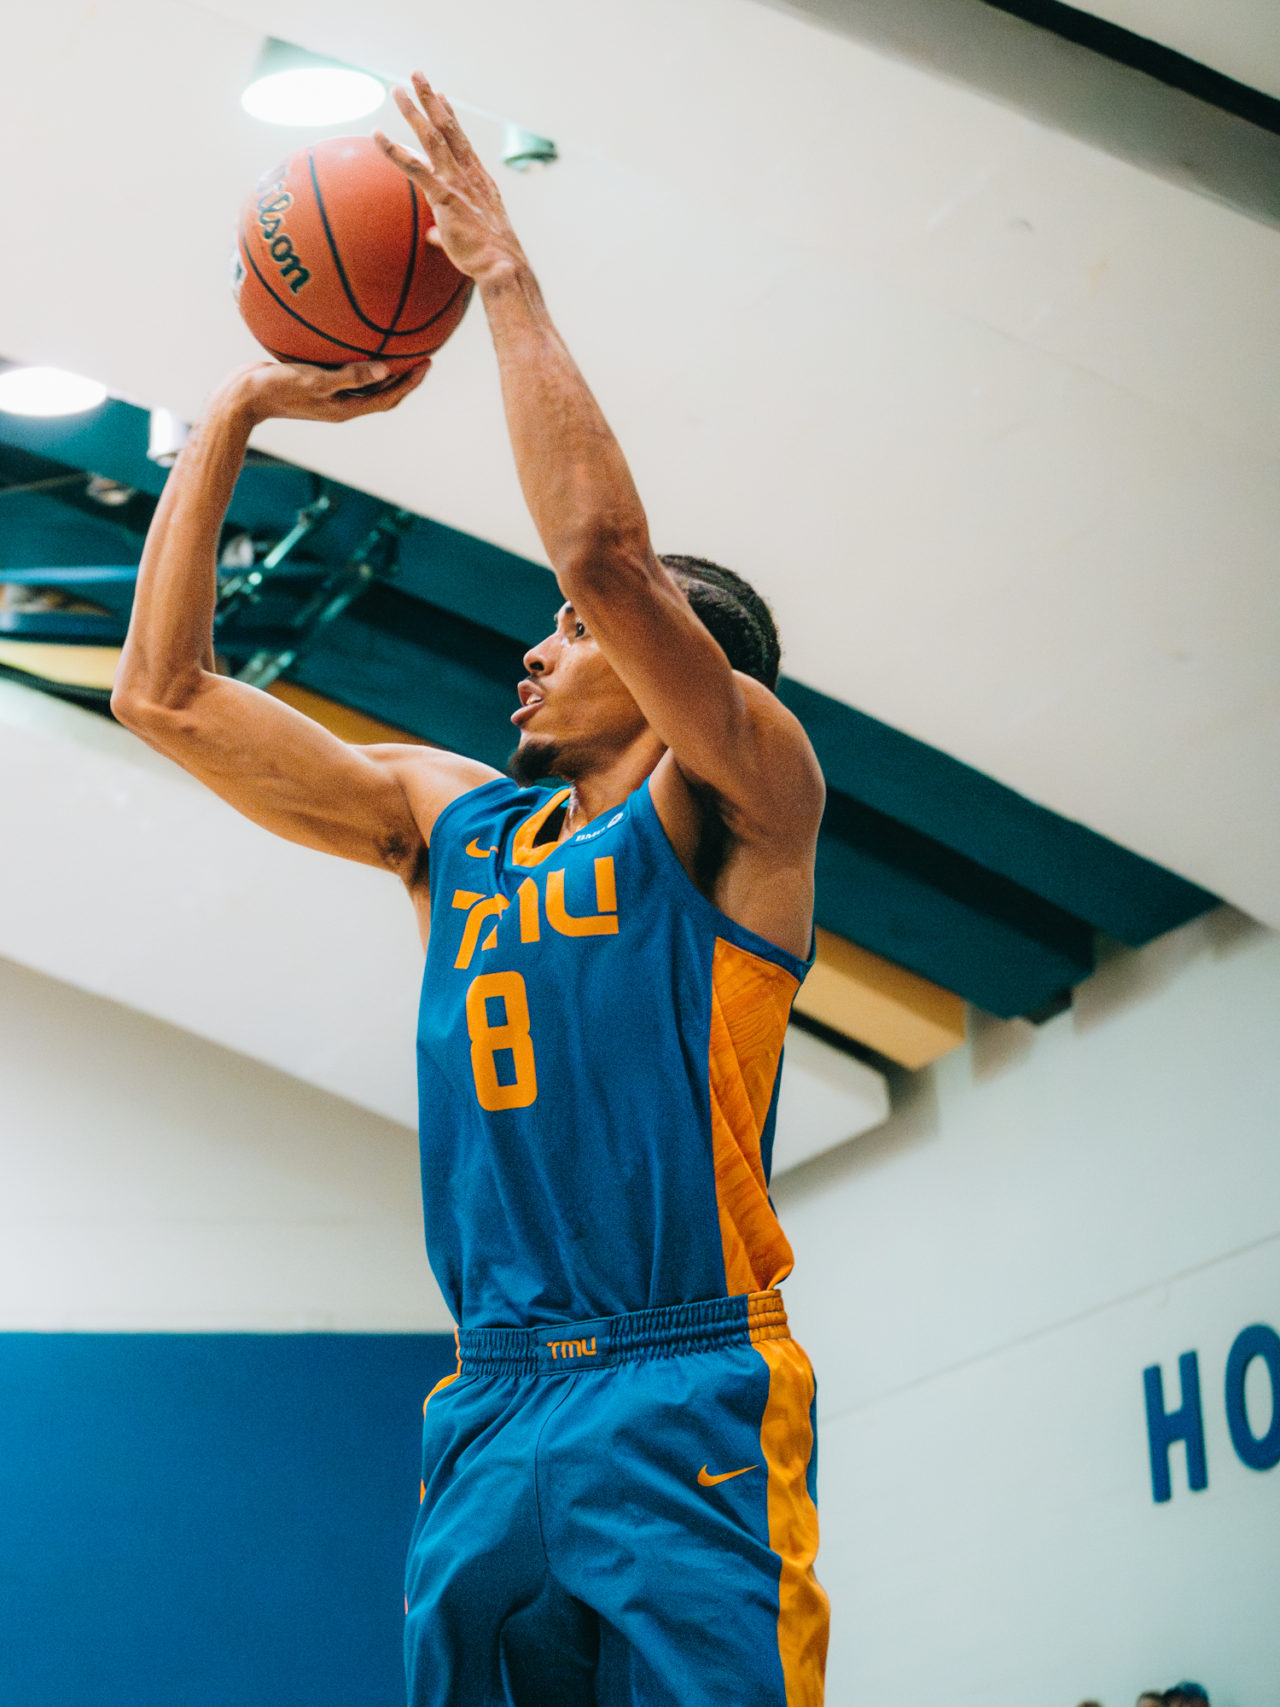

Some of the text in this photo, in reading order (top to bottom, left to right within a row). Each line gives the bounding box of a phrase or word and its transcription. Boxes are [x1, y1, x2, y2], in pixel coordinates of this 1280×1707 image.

[451, 856, 620, 970] TMU
[466, 970, 538, 1112] 8
[547, 1336, 597, 1360] TMU
[1143, 1324, 1280, 1504] HO
